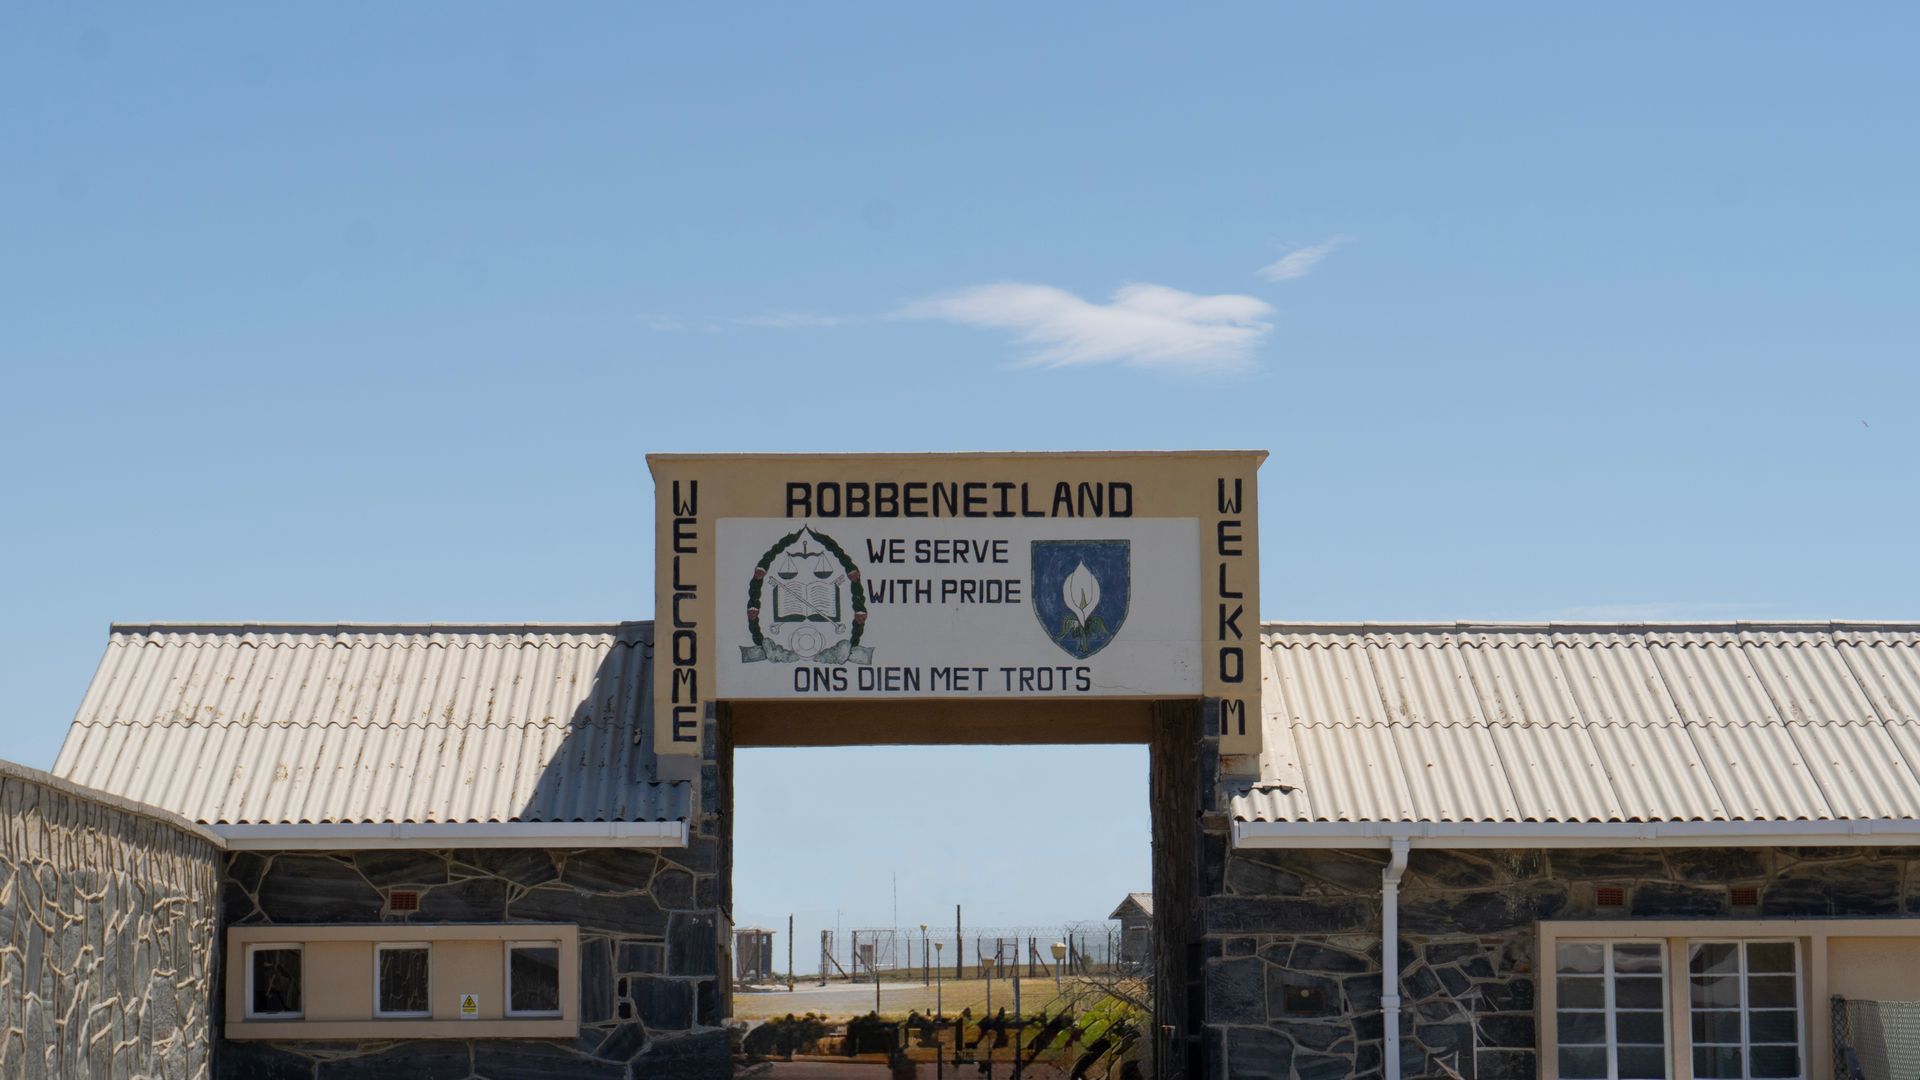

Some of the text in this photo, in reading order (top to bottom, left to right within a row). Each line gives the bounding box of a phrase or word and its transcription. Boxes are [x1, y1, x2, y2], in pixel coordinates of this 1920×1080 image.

[785, 481, 1133, 518] ROBBENEILAND
[866, 538, 1009, 564] WE SERVE
[867, 579, 1021, 604] WITH PRIDE
[1217, 478, 1246, 736] WELKOM
[671, 479, 698, 743] WELCOME
[794, 666, 1091, 692] ONS DIEN MET TROTS
